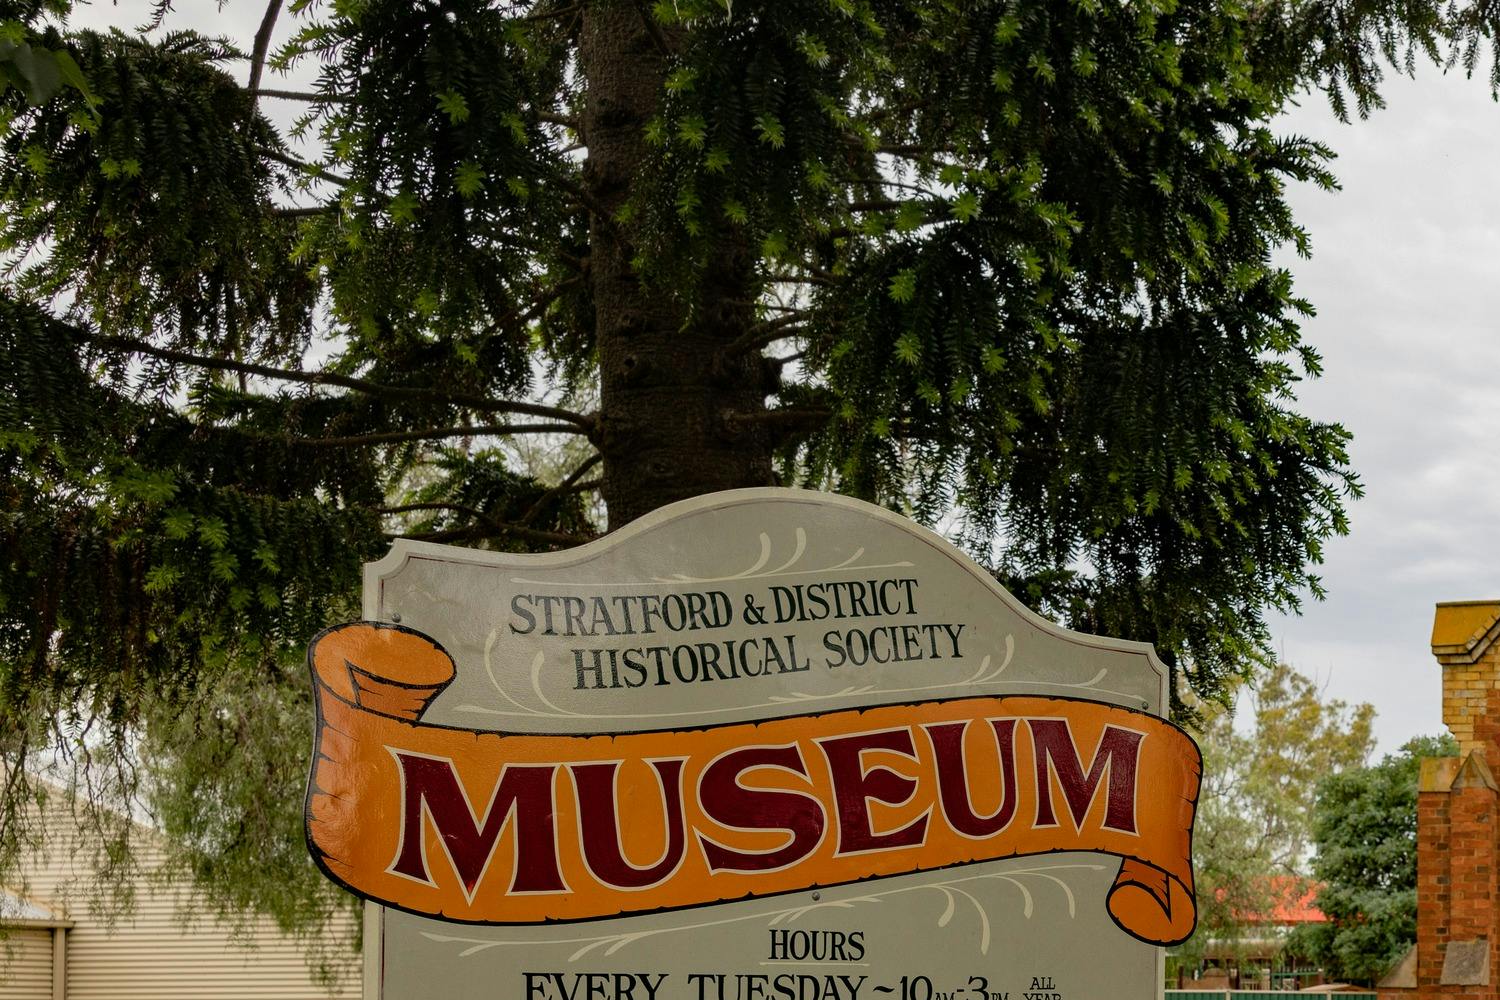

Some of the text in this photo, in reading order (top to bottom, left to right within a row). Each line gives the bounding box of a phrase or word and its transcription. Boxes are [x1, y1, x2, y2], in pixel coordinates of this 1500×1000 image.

[508, 578, 919, 637] STRATFORD & DISTRICT
[570, 623, 966, 691] HISTORICAL SOCIETY
[383, 715, 1149, 905] MUSEUM
[767, 929, 865, 962] HOURS
[1029, 976, 1056, 991] ALL
